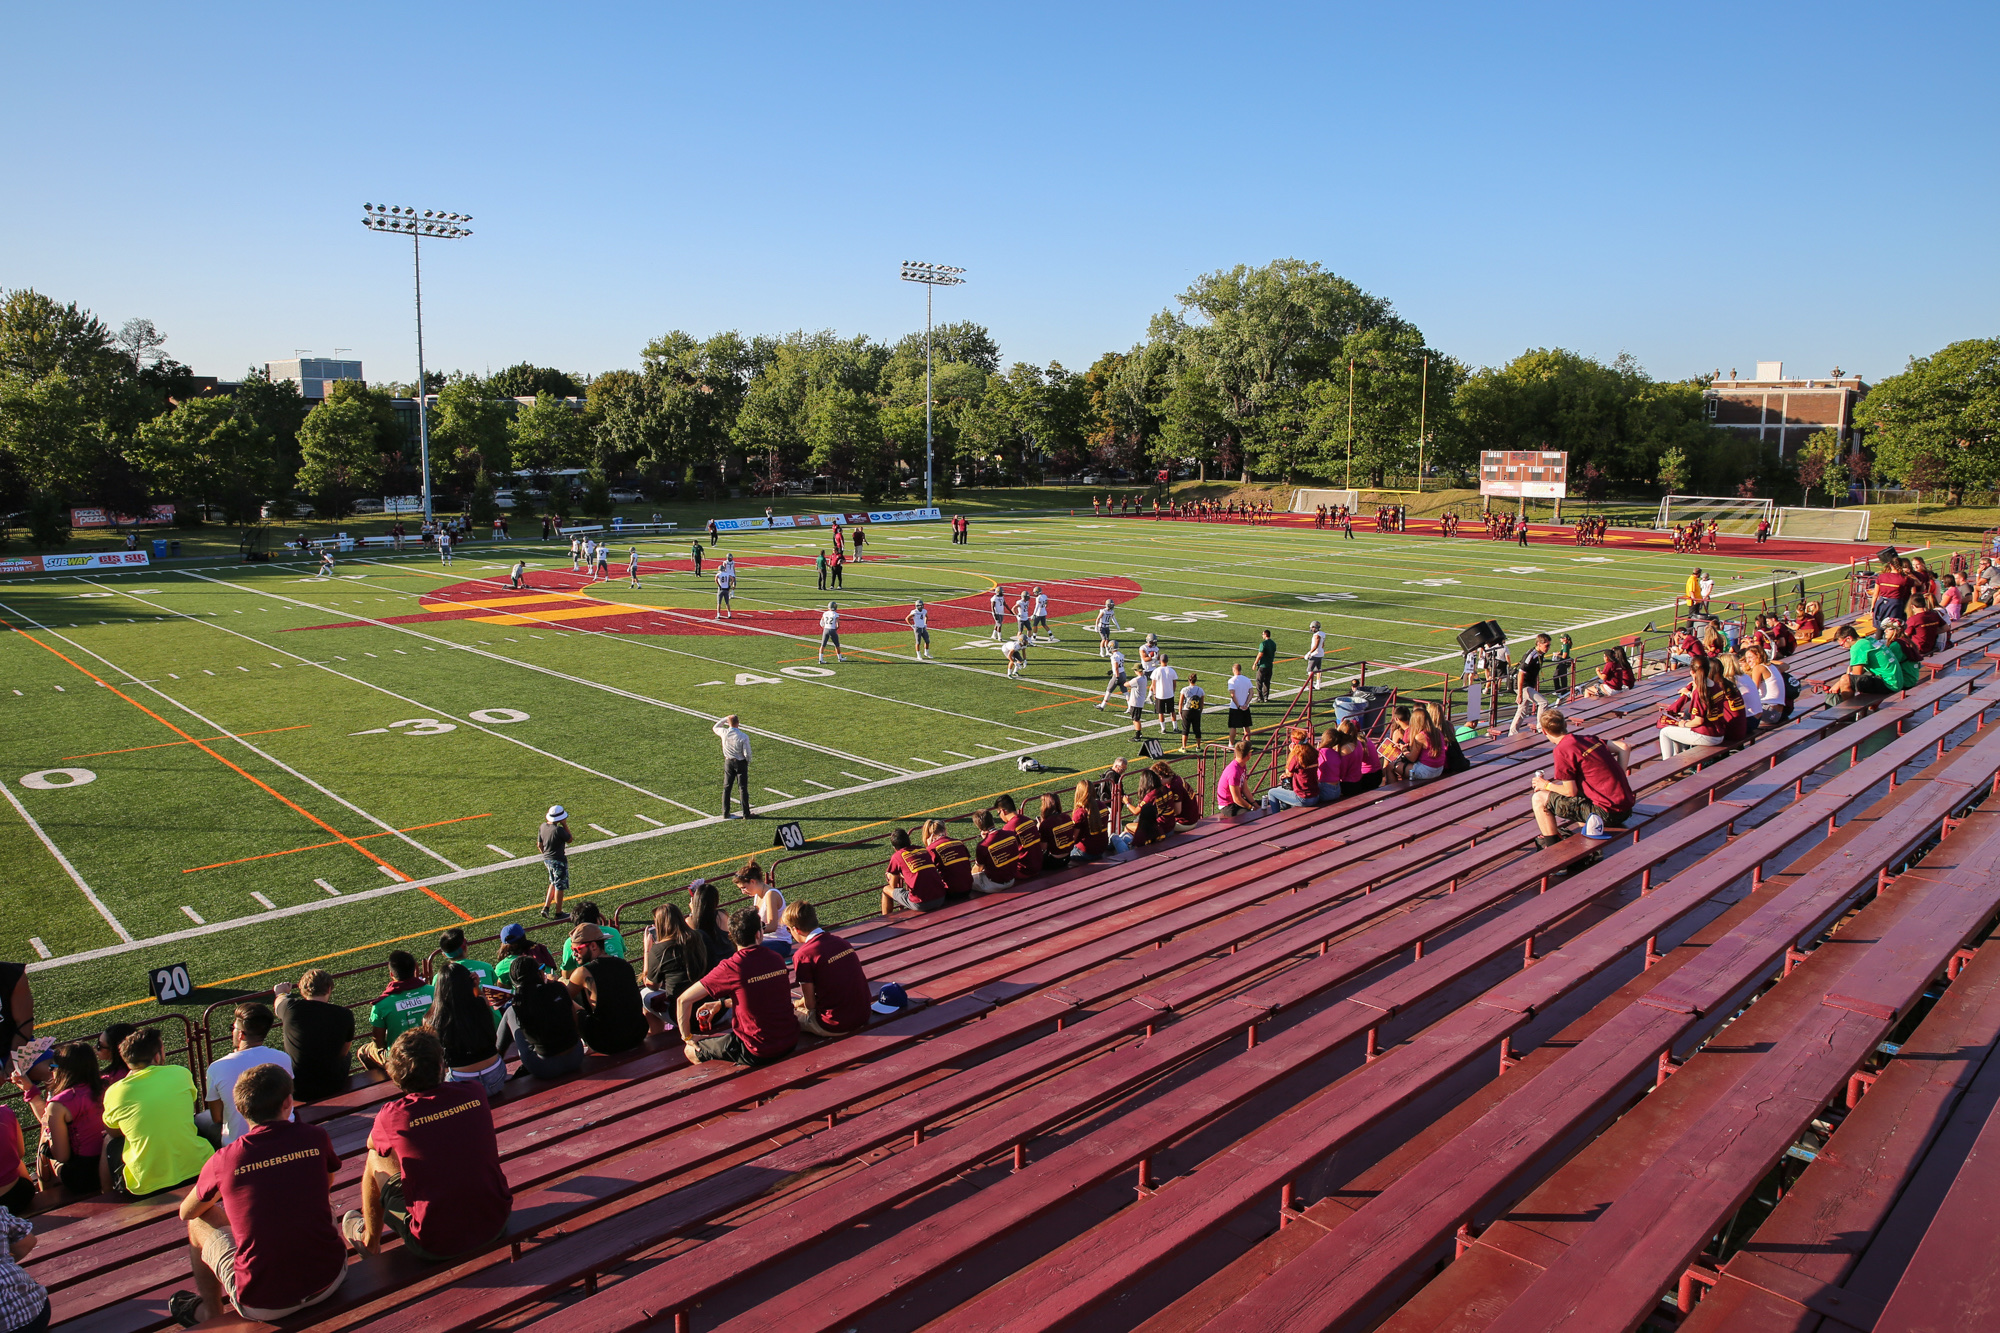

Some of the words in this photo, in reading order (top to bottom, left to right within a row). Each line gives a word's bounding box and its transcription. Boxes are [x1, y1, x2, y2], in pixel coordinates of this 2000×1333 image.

[1158, 470, 1168, 479] 20
[75, 509, 101, 519] pizza
[80, 515, 106, 525] pizza
[44, 555, 94, 568] SUBWAY
[98, 554, 122, 564] CIS
[124, 553, 147, 562] SIC
[825, 616, 834, 626] 22
[1147, 609, 1230, 624] 50
[734, 665, 838, 686] 40
[388, 707, 531, 736] 30
[1148, 739, 1163, 757] 40
[782, 824, 803, 848] 30
[157, 966, 190, 1000] 20
[400, 998, 422, 1010] CHUG
[409, 1099, 481, 1128] #STINGERSUNITED
[233, 1148, 320, 1176] #STINGERSUNITED
